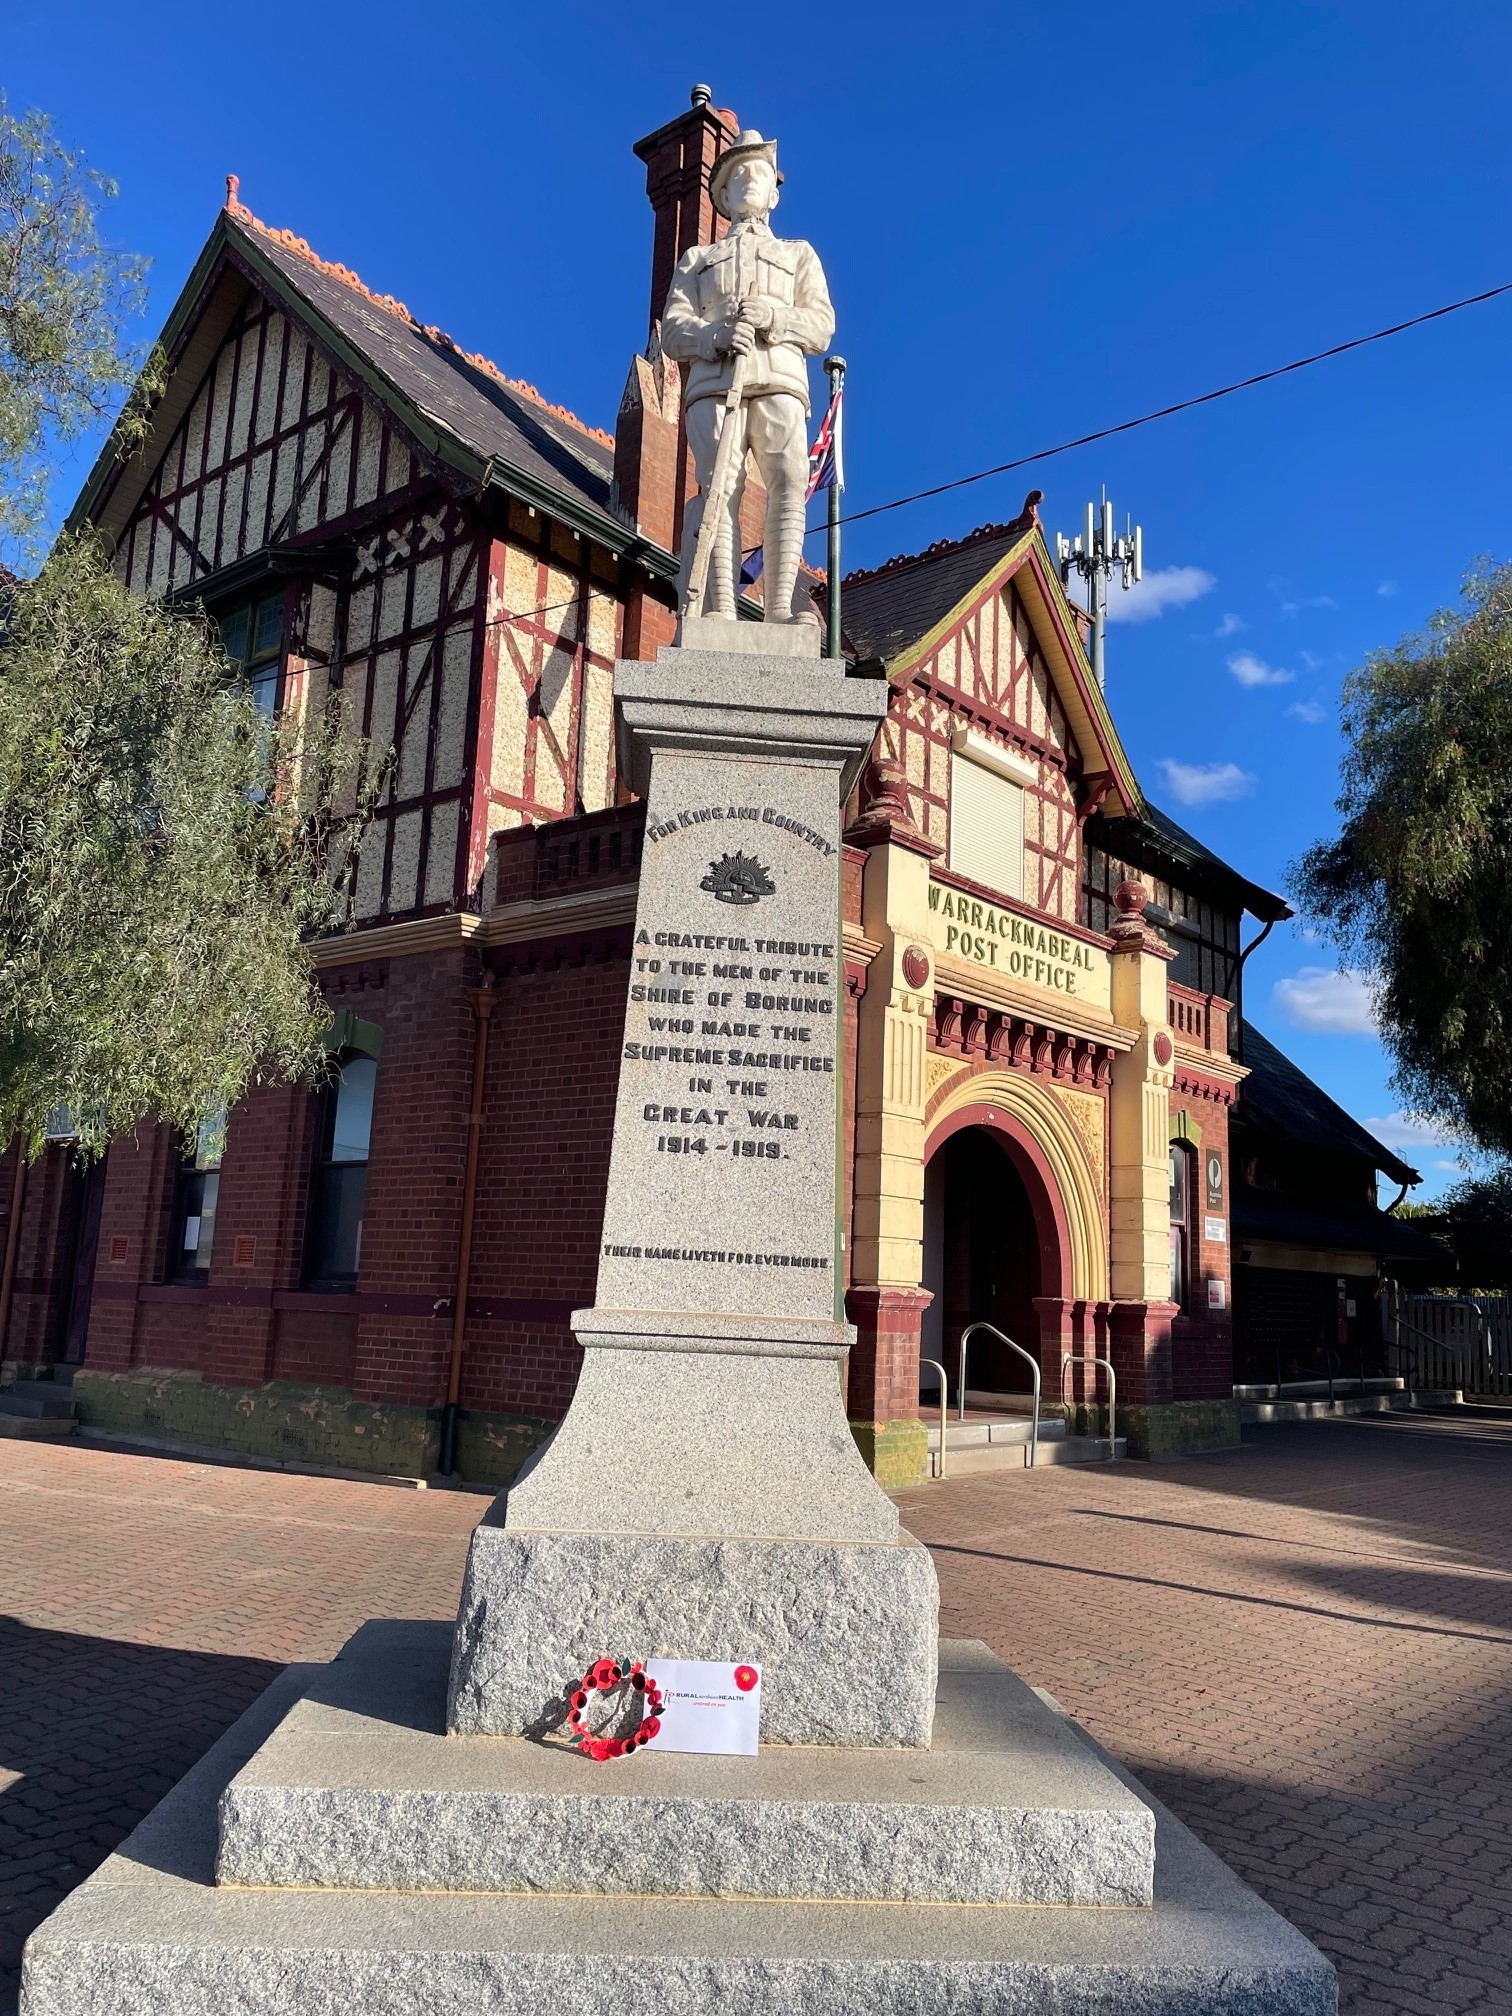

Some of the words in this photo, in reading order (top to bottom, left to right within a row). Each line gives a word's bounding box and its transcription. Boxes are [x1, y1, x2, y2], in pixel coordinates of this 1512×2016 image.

[647, 819, 680, 843] FOR
[677, 807, 724, 829] KING
[726, 806, 761, 821] AND
[762, 807, 838, 858] COUNTRY
[928, 884, 1095, 971] WARRACKNABEAL
[635, 929, 650, 945] A
[654, 932, 750, 951] GRATEFUL
[754, 939, 835, 958] TRIBUTE
[635, 958, 662, 973] TO
[669, 960, 707, 976] THE
[713, 963, 753, 979] MEN
[759, 967, 783, 982] OF
[789, 969, 830, 985] THE
[945, 925, 999, 965] POST
[1009, 950, 1077, 994] OFFICE
[630, 984, 695, 1005] SHIRE
[707, 991, 733, 1007] OF
[745, 991, 833, 1014] BORUNG
[648, 1017, 695, 1034] WHO
[701, 1020, 761, 1038] MADE
[770, 1025, 812, 1042] THE
[624, 1042, 724, 1065] SUPREME
[728, 1049, 834, 1072] SACRIFICE
[688, 1077, 713, 1094] IN
[726, 1080, 768, 1096] THE
[643, 1103, 729, 1126] GREAT
[747, 1110, 800, 1130] WAR
[604, 1244, 642, 1258] THEIR
[644, 1246, 681, 1260] NAME
[681, 1249, 726, 1263] LIVETH
